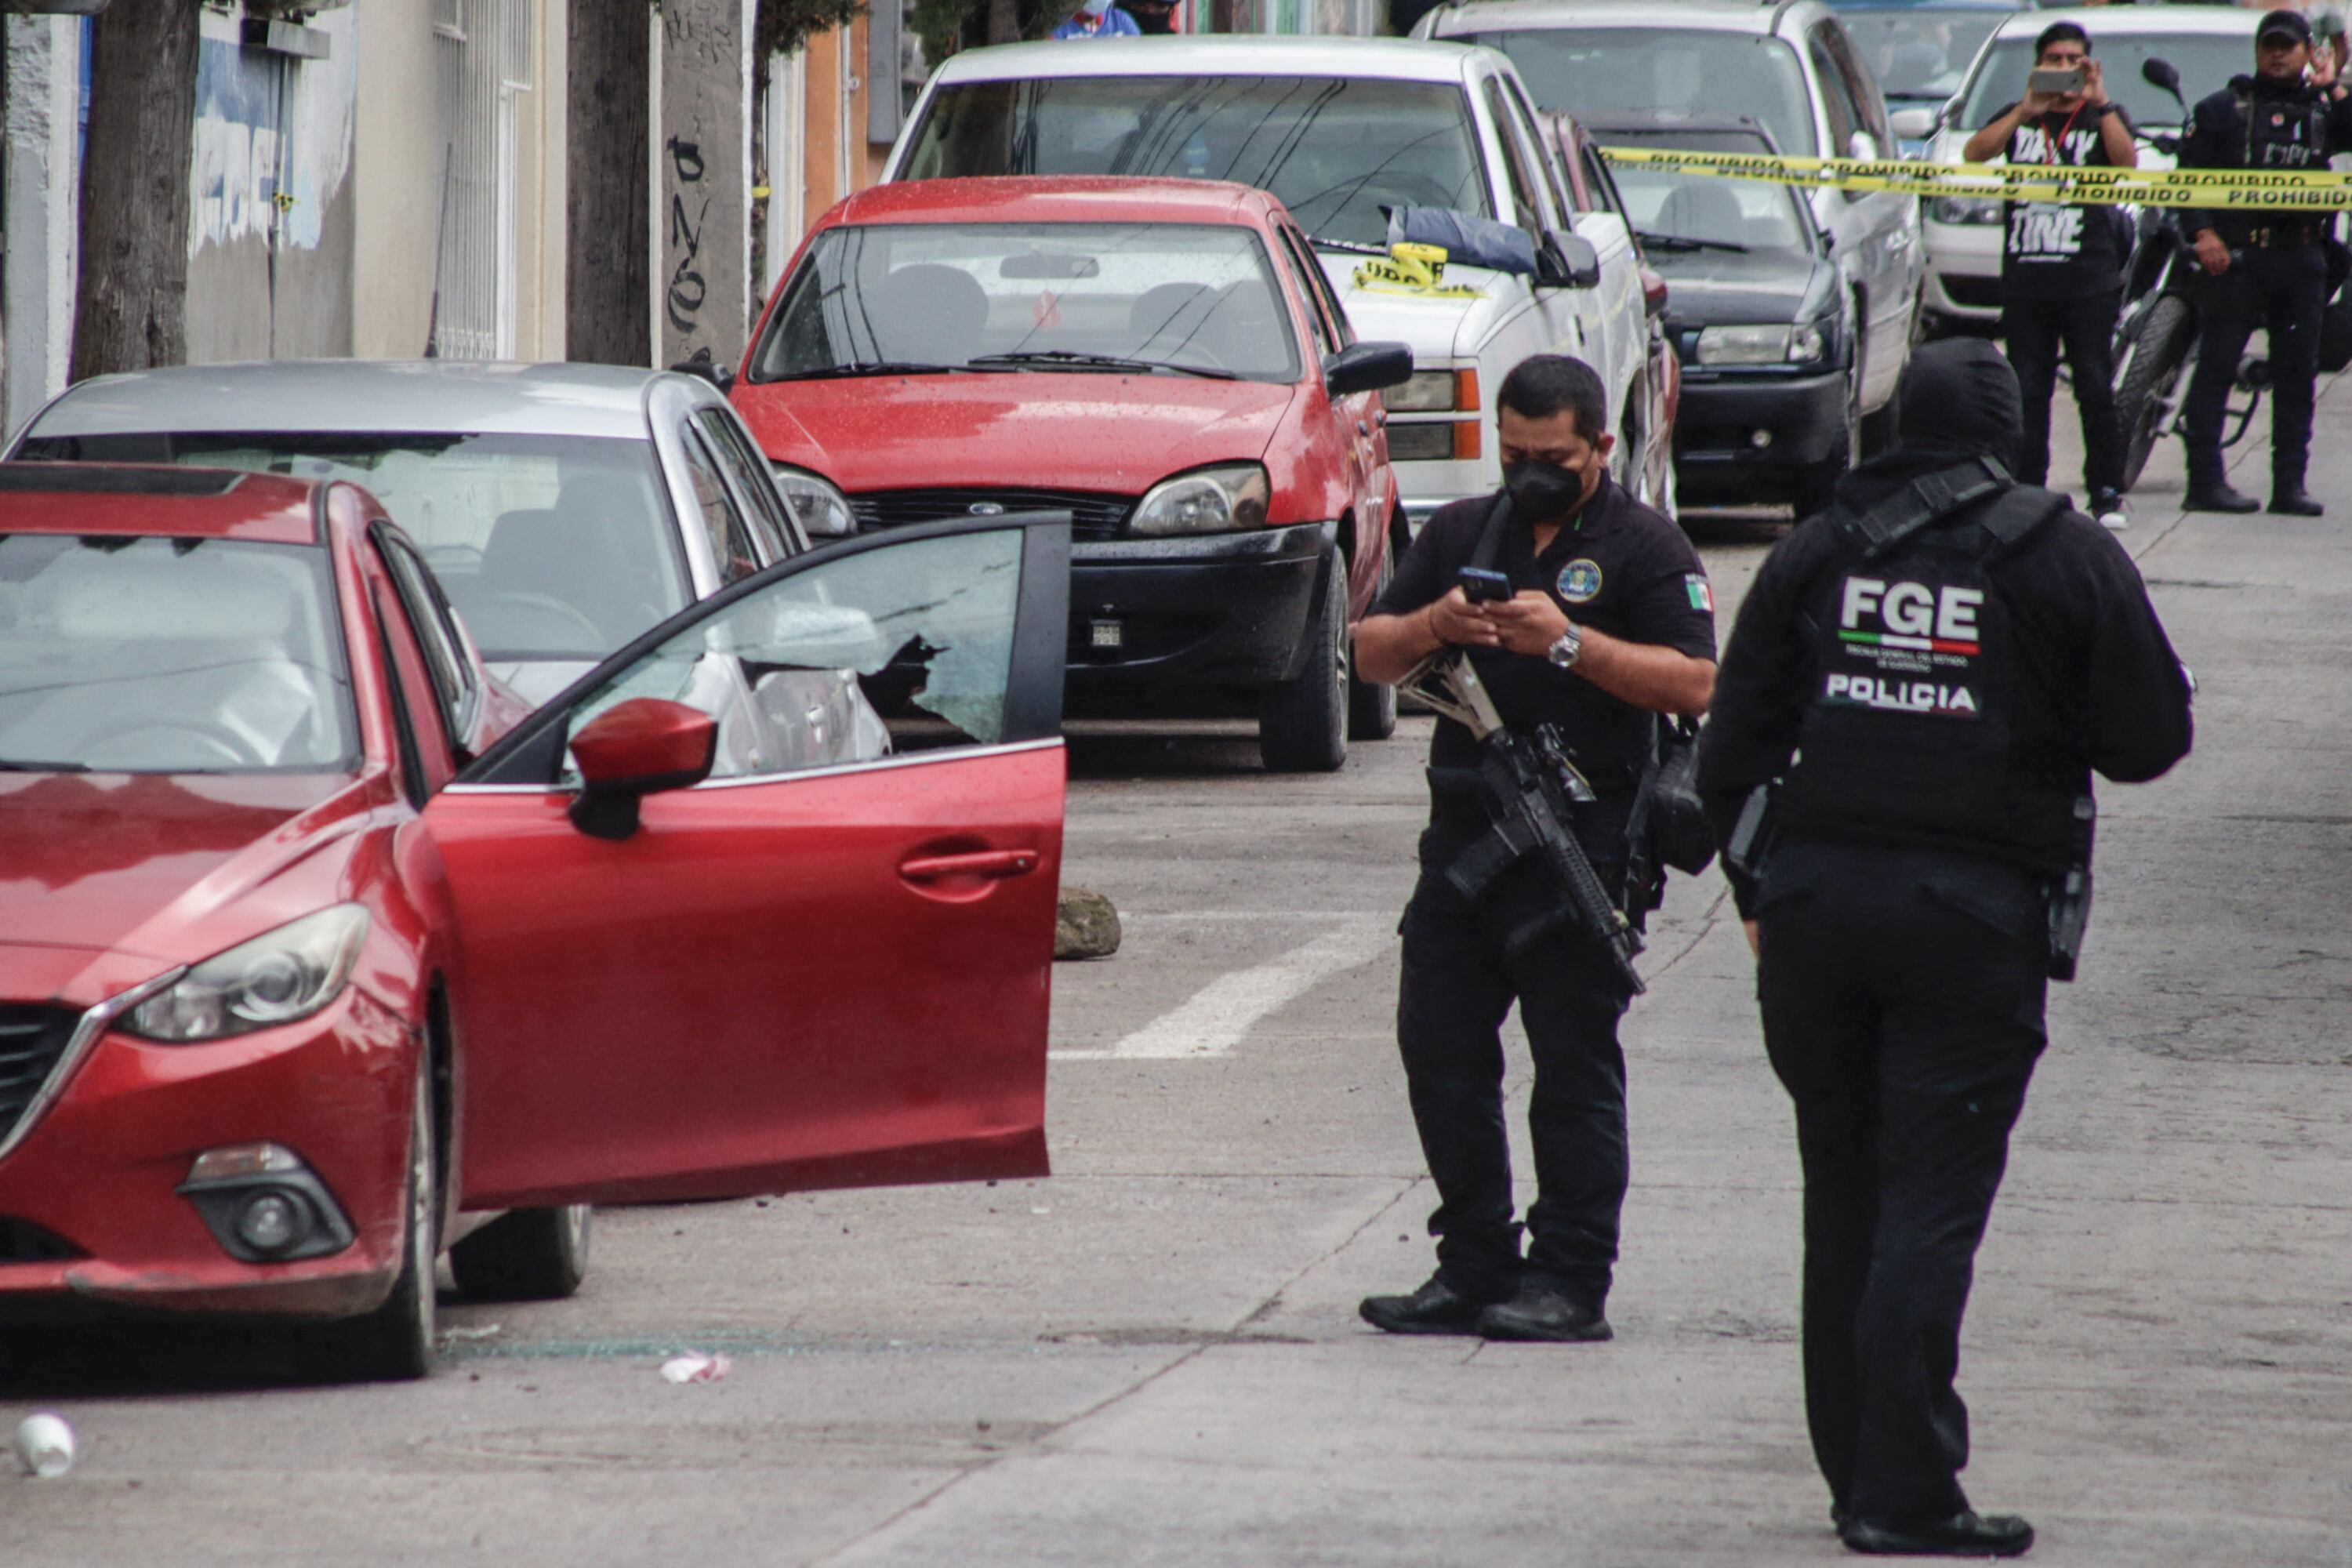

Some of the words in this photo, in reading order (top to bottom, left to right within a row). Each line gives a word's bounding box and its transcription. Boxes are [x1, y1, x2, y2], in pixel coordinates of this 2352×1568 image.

[2056, 185, 2192, 202] PROHIBIDO
[2167, 173, 2306, 187] PROHIBIDO
[1841, 576, 1984, 641] FGE
[1826, 674, 1976, 712] POLICIA
